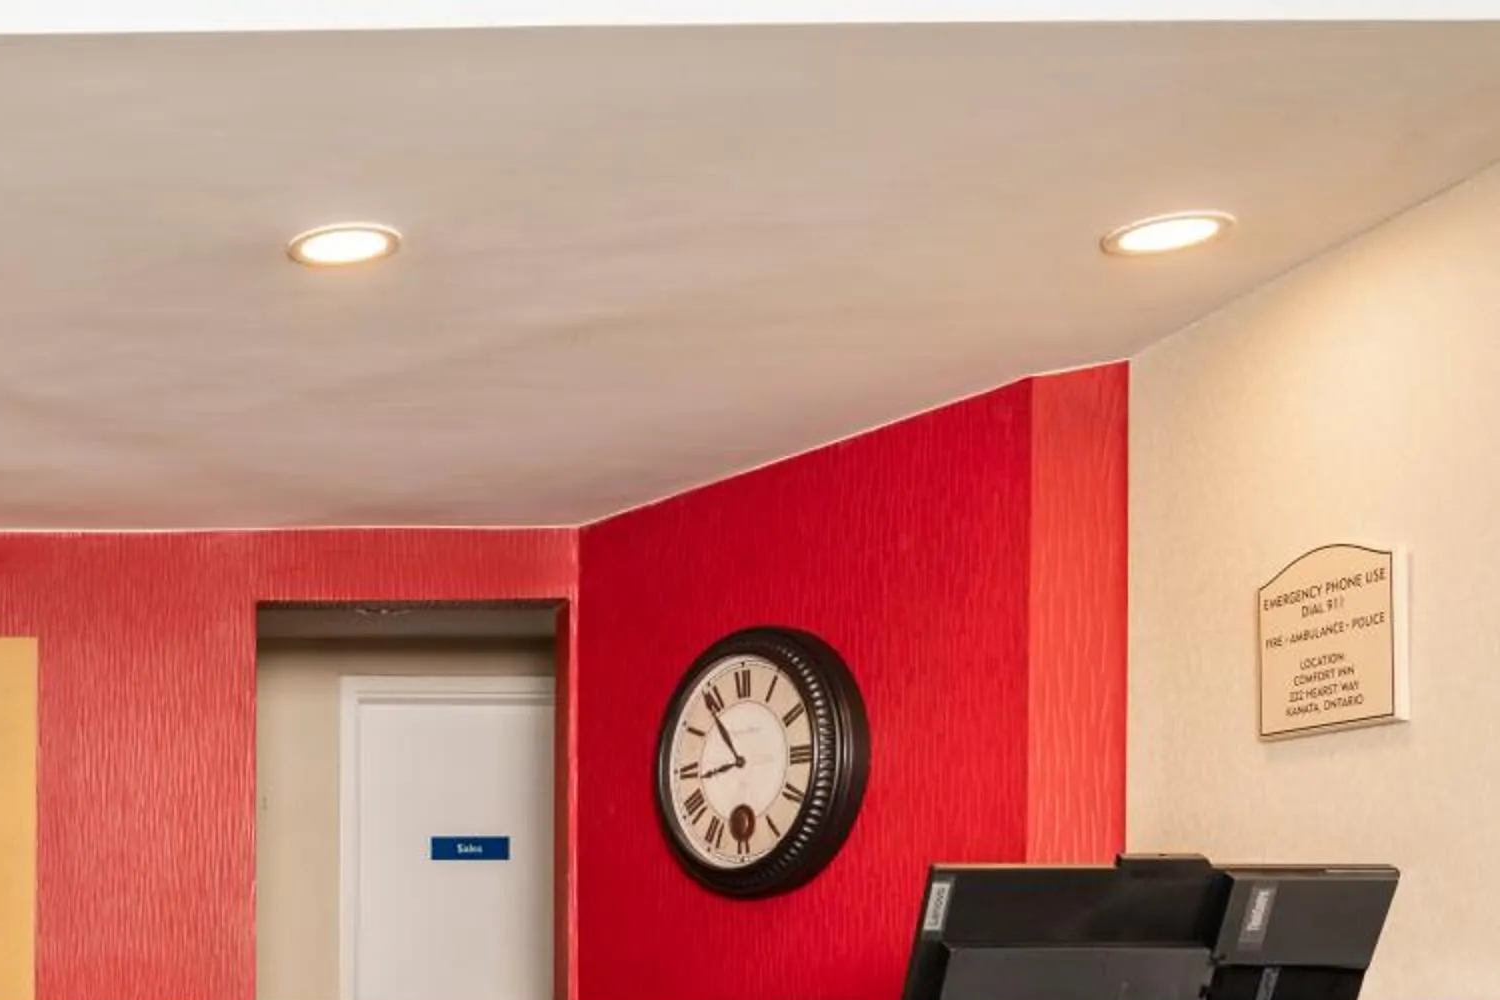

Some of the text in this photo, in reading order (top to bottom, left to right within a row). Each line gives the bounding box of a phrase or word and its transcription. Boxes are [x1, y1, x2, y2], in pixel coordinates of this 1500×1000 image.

[1263, 568, 1386, 611] EMERGENCY PHONE USE
[1301, 605, 1324, 618] DIAL
[1265, 611, 1385, 649] FIRE AMBULANCE POLICE
[1300, 653, 1344, 670] LOCATION
[1293, 666, 1355, 686] COMFORT INN
[1305, 683, 1338, 699] HEARST
[1341, 681, 1359, 691] WAY
[1323, 693, 1364, 711] ONTARIO
